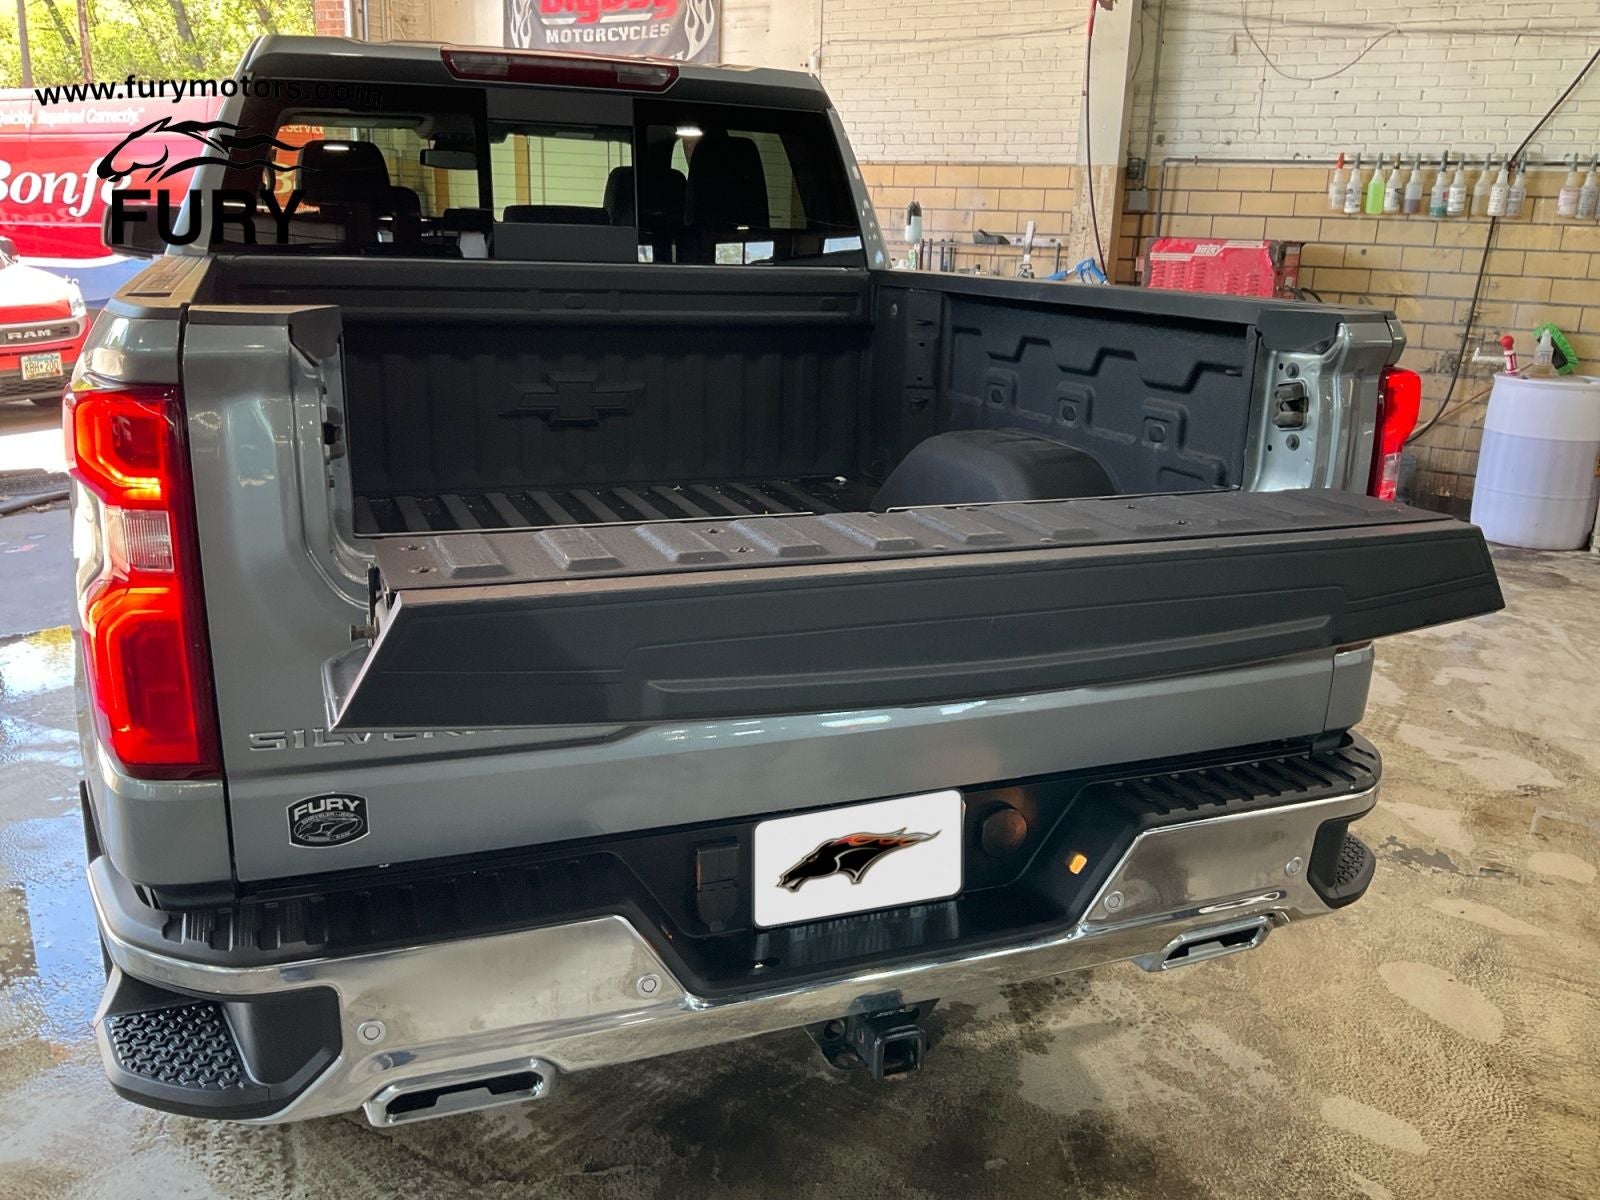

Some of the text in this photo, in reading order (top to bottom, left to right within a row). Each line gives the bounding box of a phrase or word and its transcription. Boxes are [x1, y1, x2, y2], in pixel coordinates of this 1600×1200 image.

[545, 23, 670, 44] MOTORCYCLES
[7, 330, 51, 340] RAM
[293, 797, 360, 822] FURY
